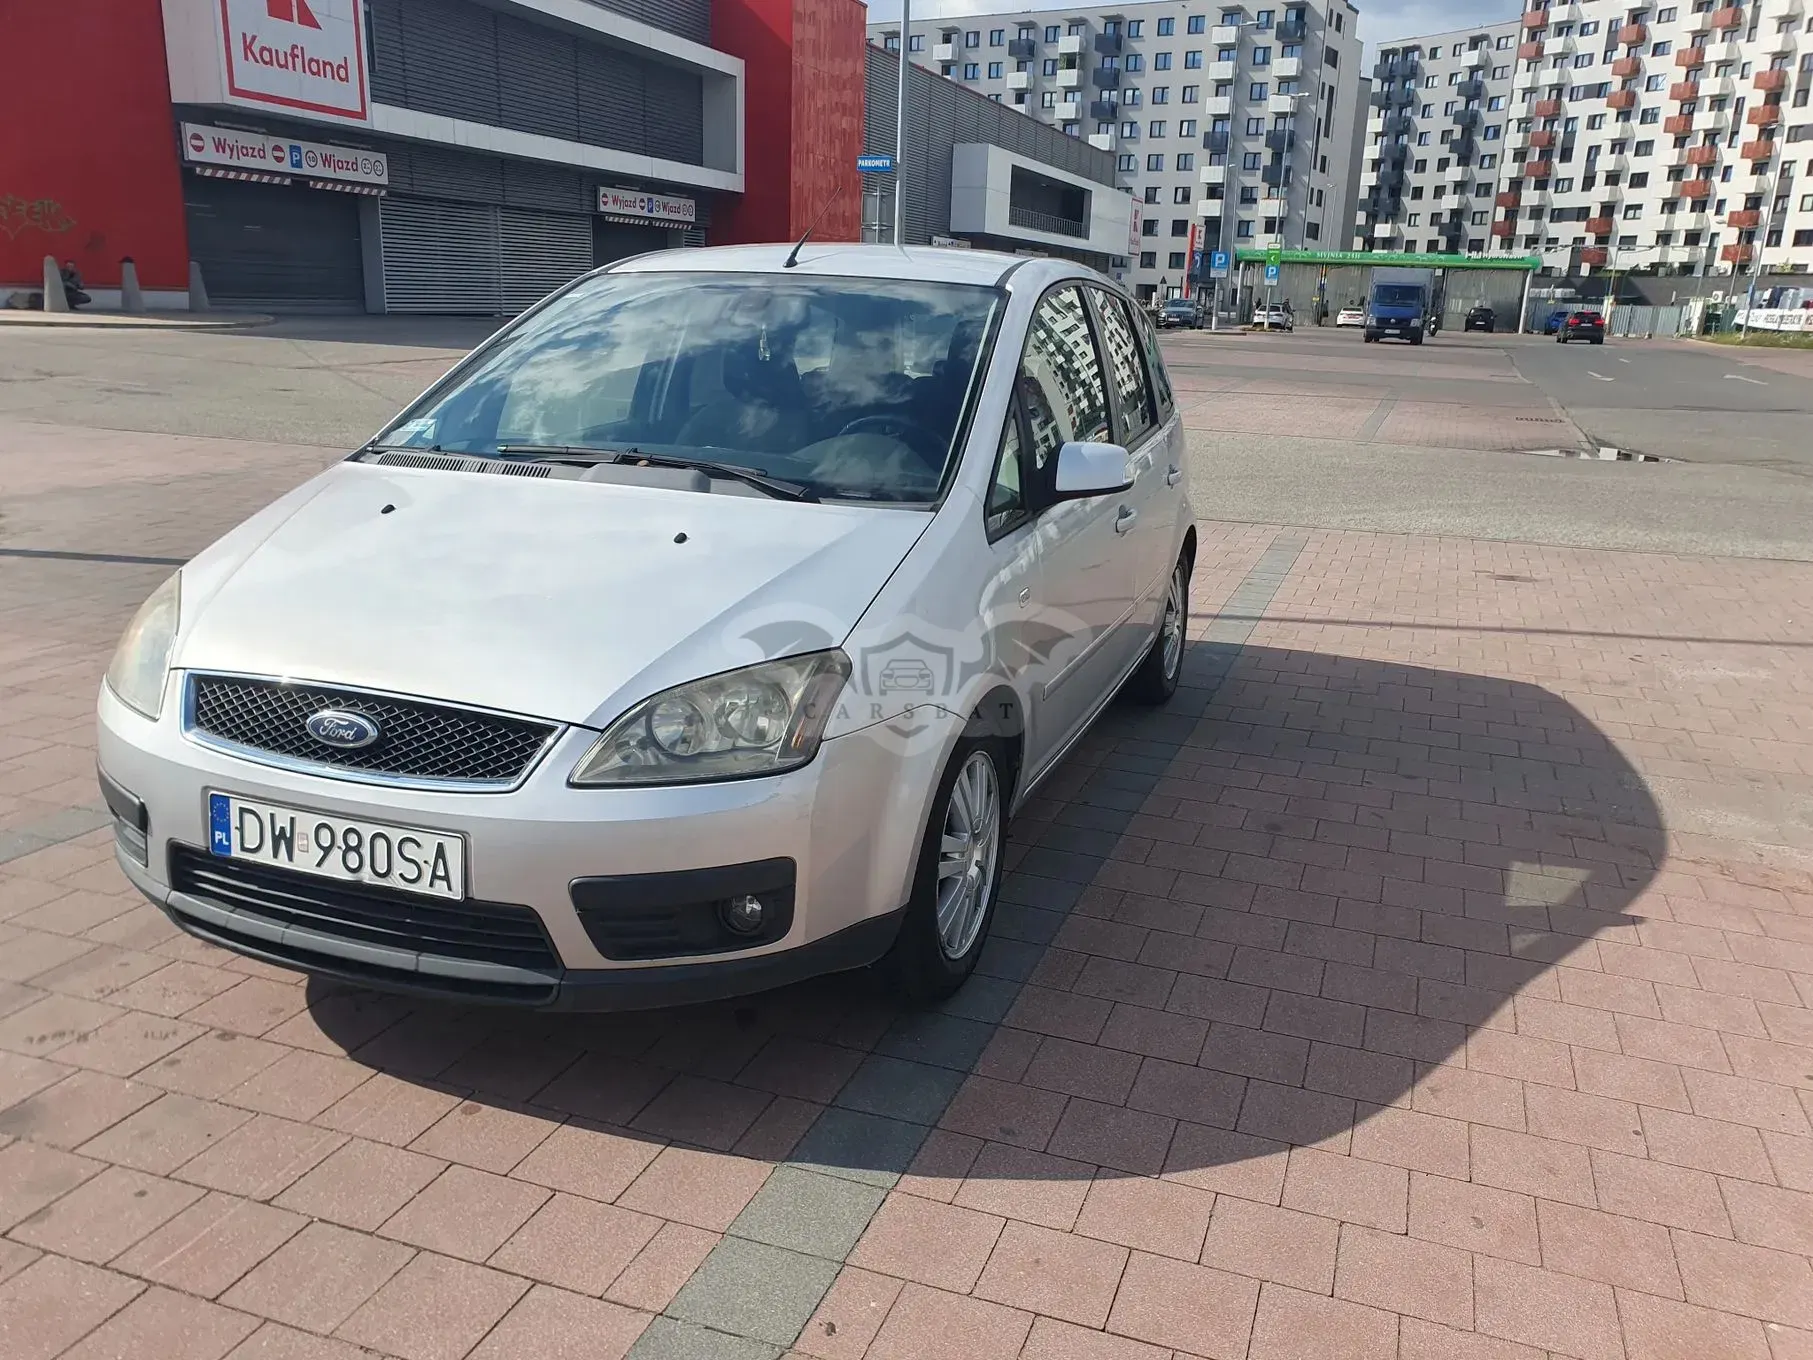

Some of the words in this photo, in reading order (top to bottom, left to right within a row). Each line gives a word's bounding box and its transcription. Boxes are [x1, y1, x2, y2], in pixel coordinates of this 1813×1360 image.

[242, 32, 349, 83] Kaufland
[212, 136, 266, 161] Wyjazd
[320, 152, 358, 173] Wjazd
[858, 159, 890, 168] PARKOMETR
[611, 194, 637, 210] Wyjazd
[662, 201, 681, 215] Wjazd
[1215, 253, 1226, 267] P
[1268, 266, 1277, 278] P
[319, 717, 357, 741] Ford
[214, 830, 230, 846] PL
[238, 806, 297, 863] DW
[313, 821, 453, 892] 980SA
